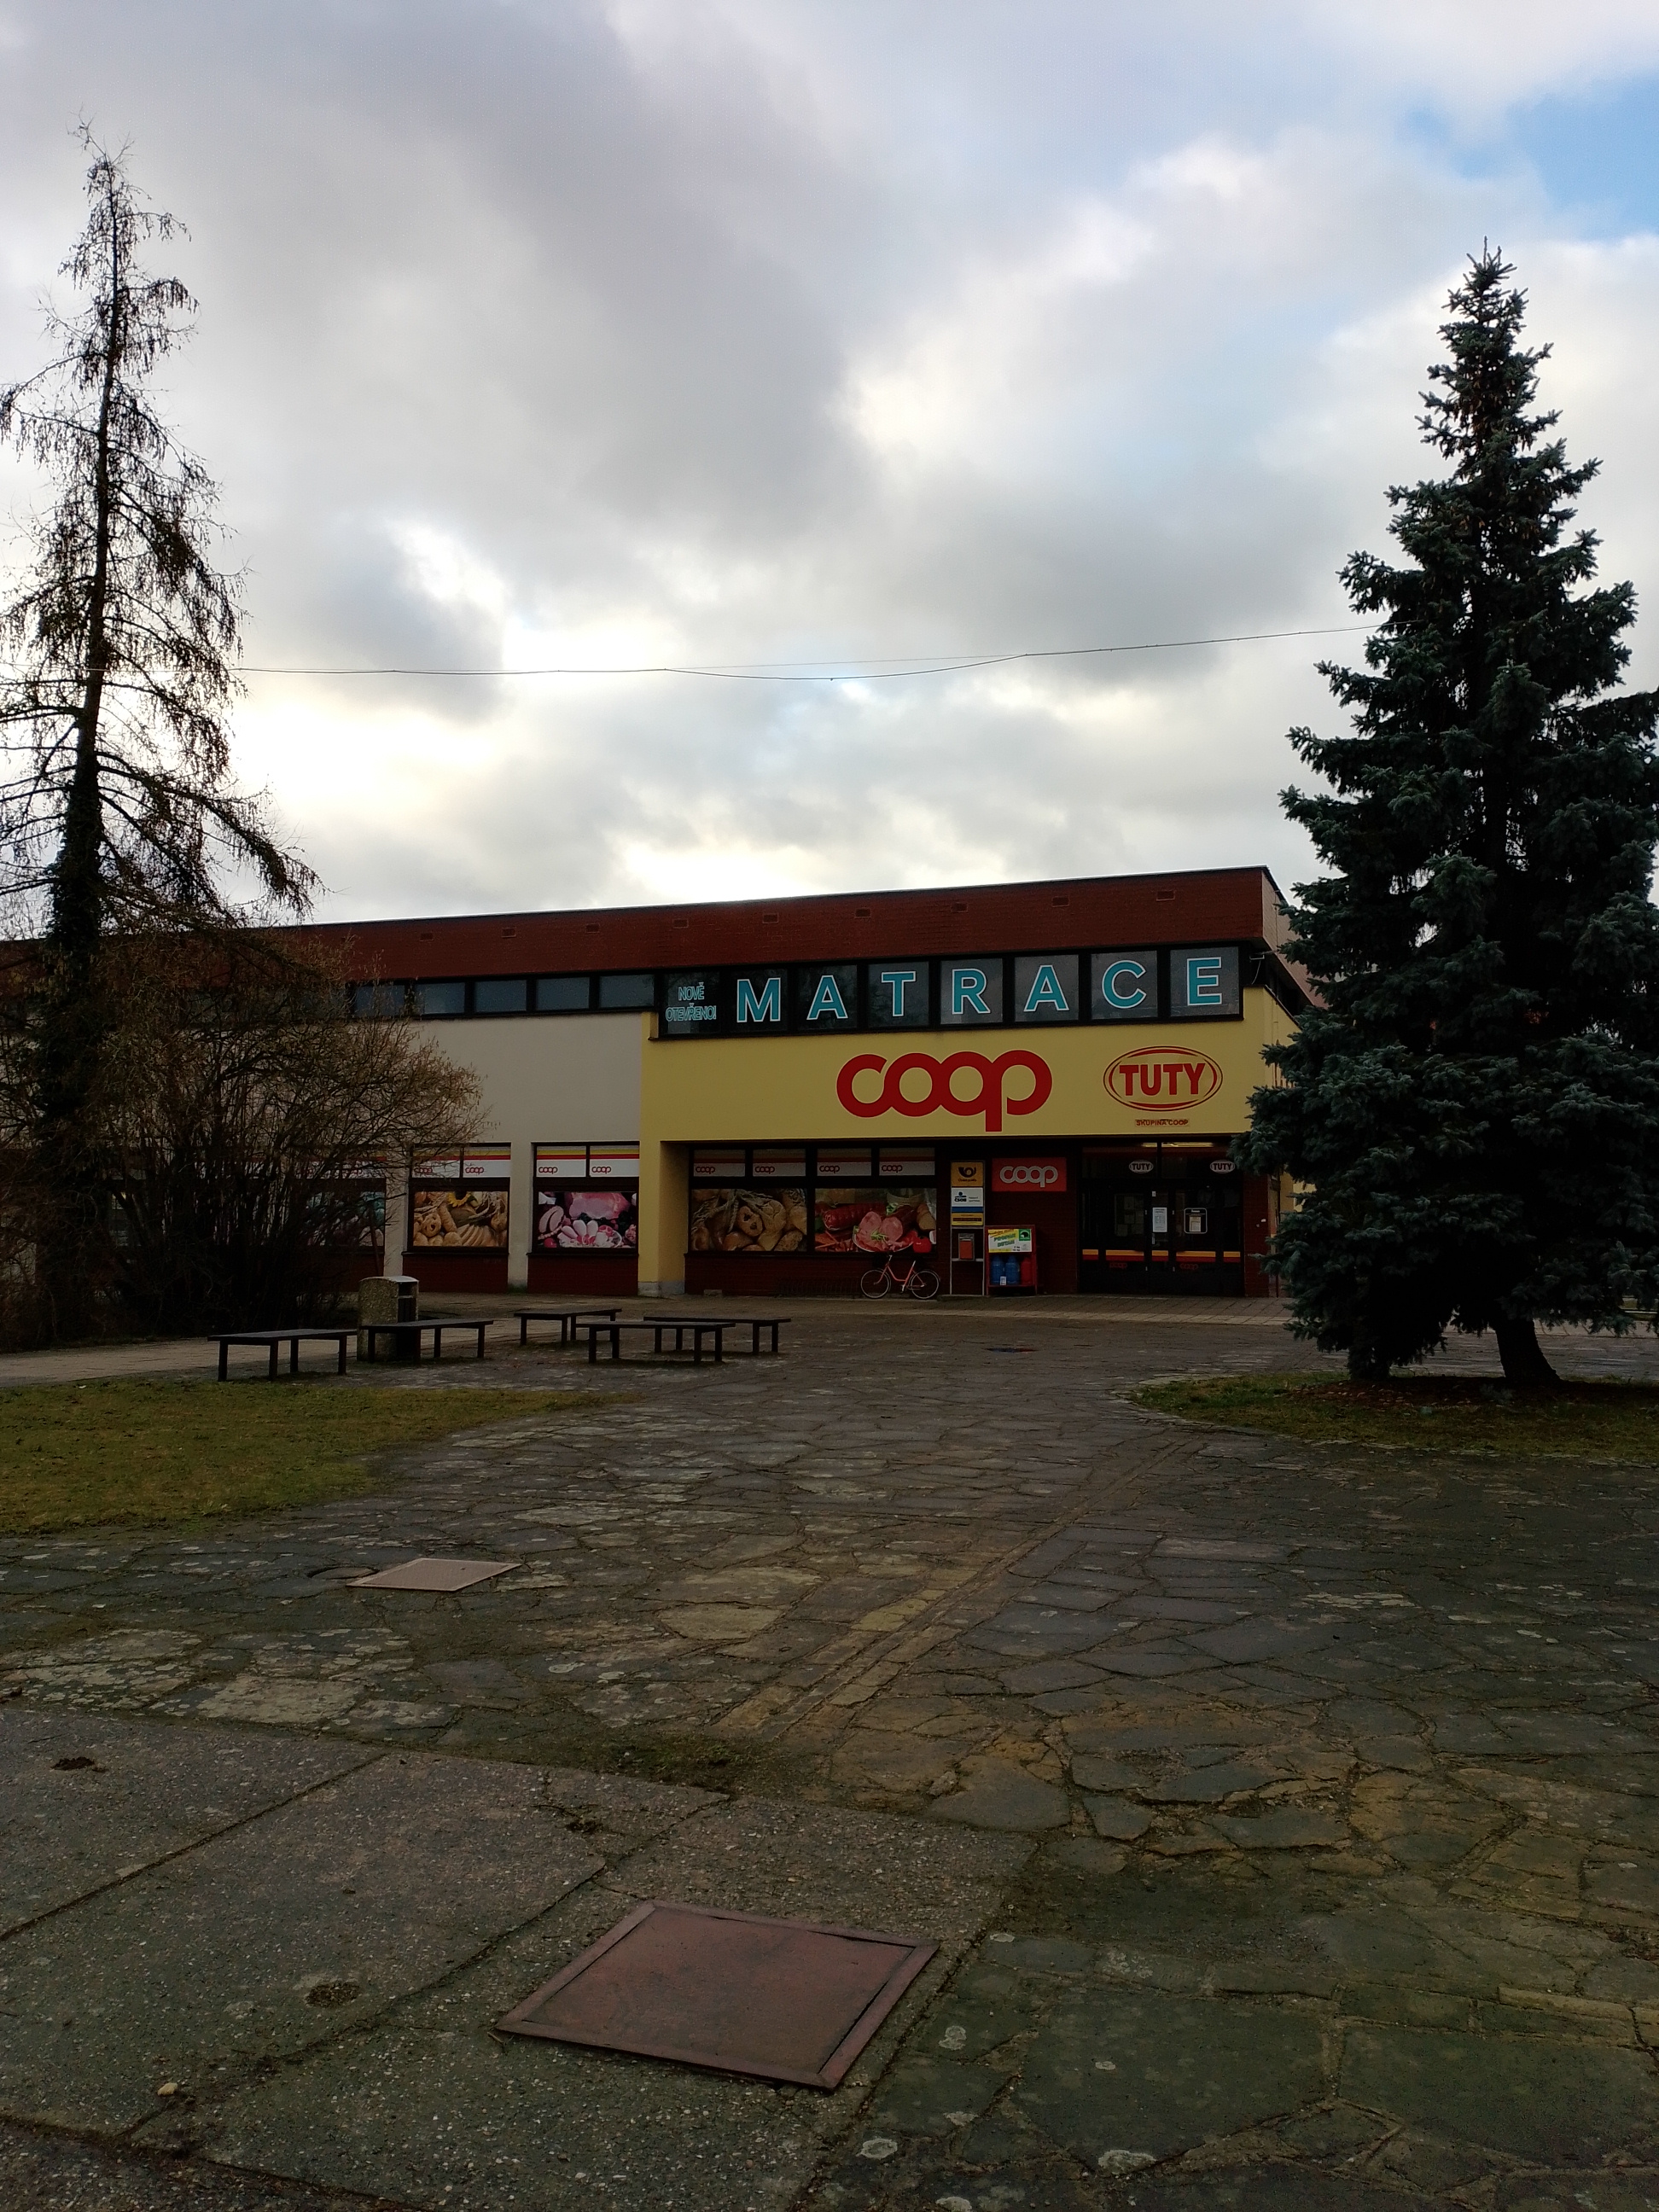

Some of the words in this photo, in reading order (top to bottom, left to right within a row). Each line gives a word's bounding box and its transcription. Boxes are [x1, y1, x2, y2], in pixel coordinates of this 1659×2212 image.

[678, 981, 704, 1000] NOVĚ
[736, 957, 1221, 1023] MATRACE
[666, 1002, 716, 1022] OTEVŘENO!
[836, 1049, 1052, 1132] coop
[1119, 1062, 1206, 1097] TUTY
[999, 1166, 1058, 1187] coop
